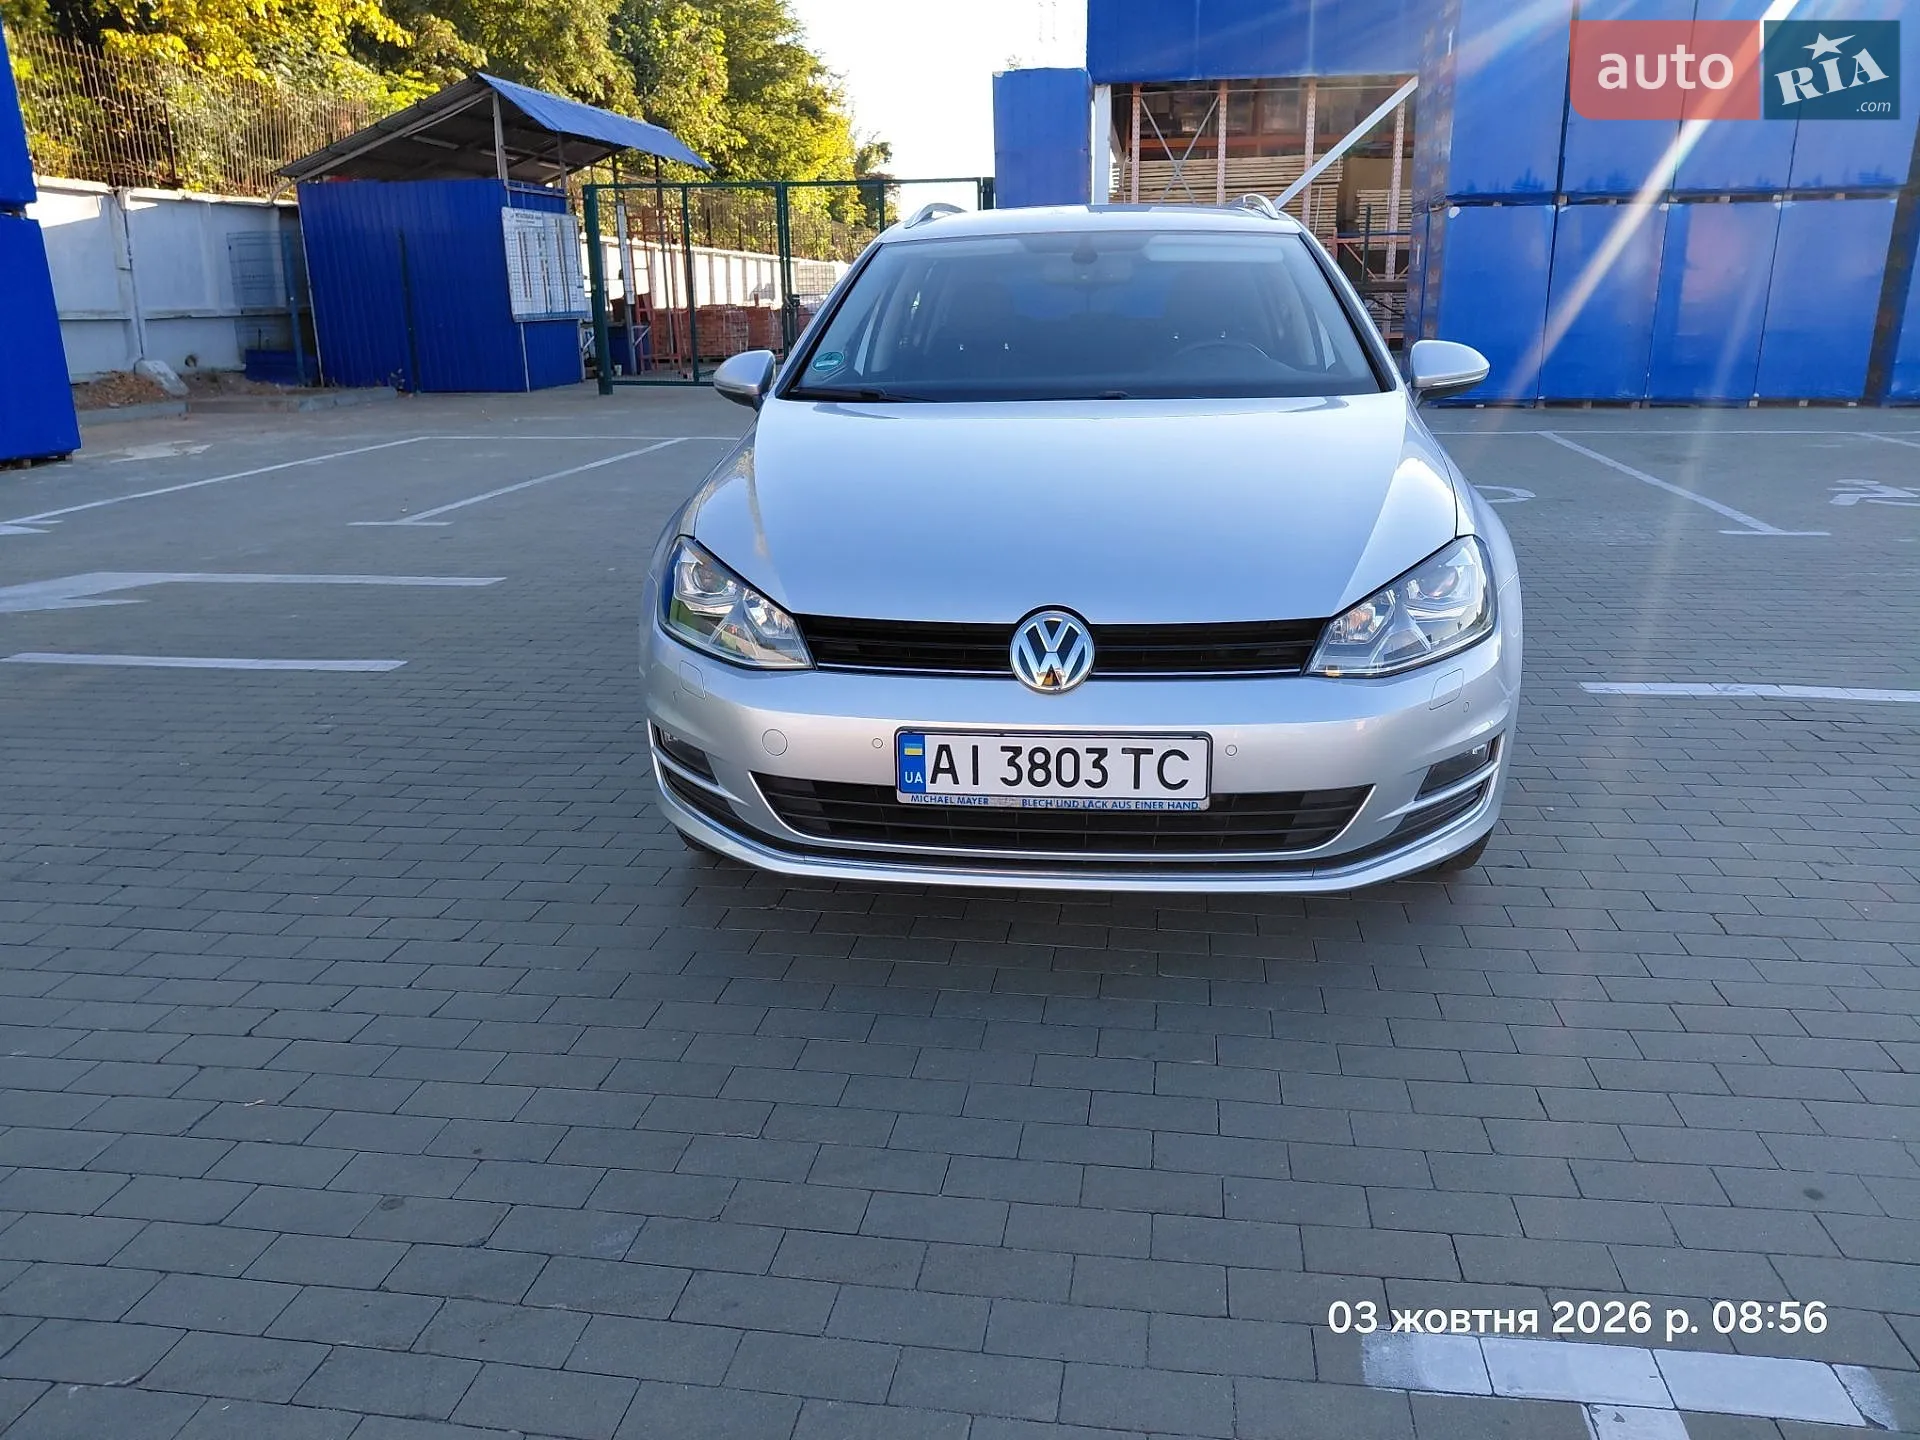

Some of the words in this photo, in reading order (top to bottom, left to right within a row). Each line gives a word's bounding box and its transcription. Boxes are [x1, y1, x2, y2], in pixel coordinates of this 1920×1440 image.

[1013, 614, 1092, 691] VW
[904, 771, 924, 785] UA
[929, 743, 979, 786] AI
[999, 745, 1109, 791] 3803
[1121, 747, 1190, 791] TC
[910, 794, 955, 805] MICHAEL
[956, 795, 990, 806] MAYER
[1021, 798, 1052, 808] BLECH
[1056, 799, 1079, 809] UND
[1082, 799, 1109, 810] LACK
[1111, 800, 1132, 810] AUS
[1135, 800, 1165, 811] EINER
